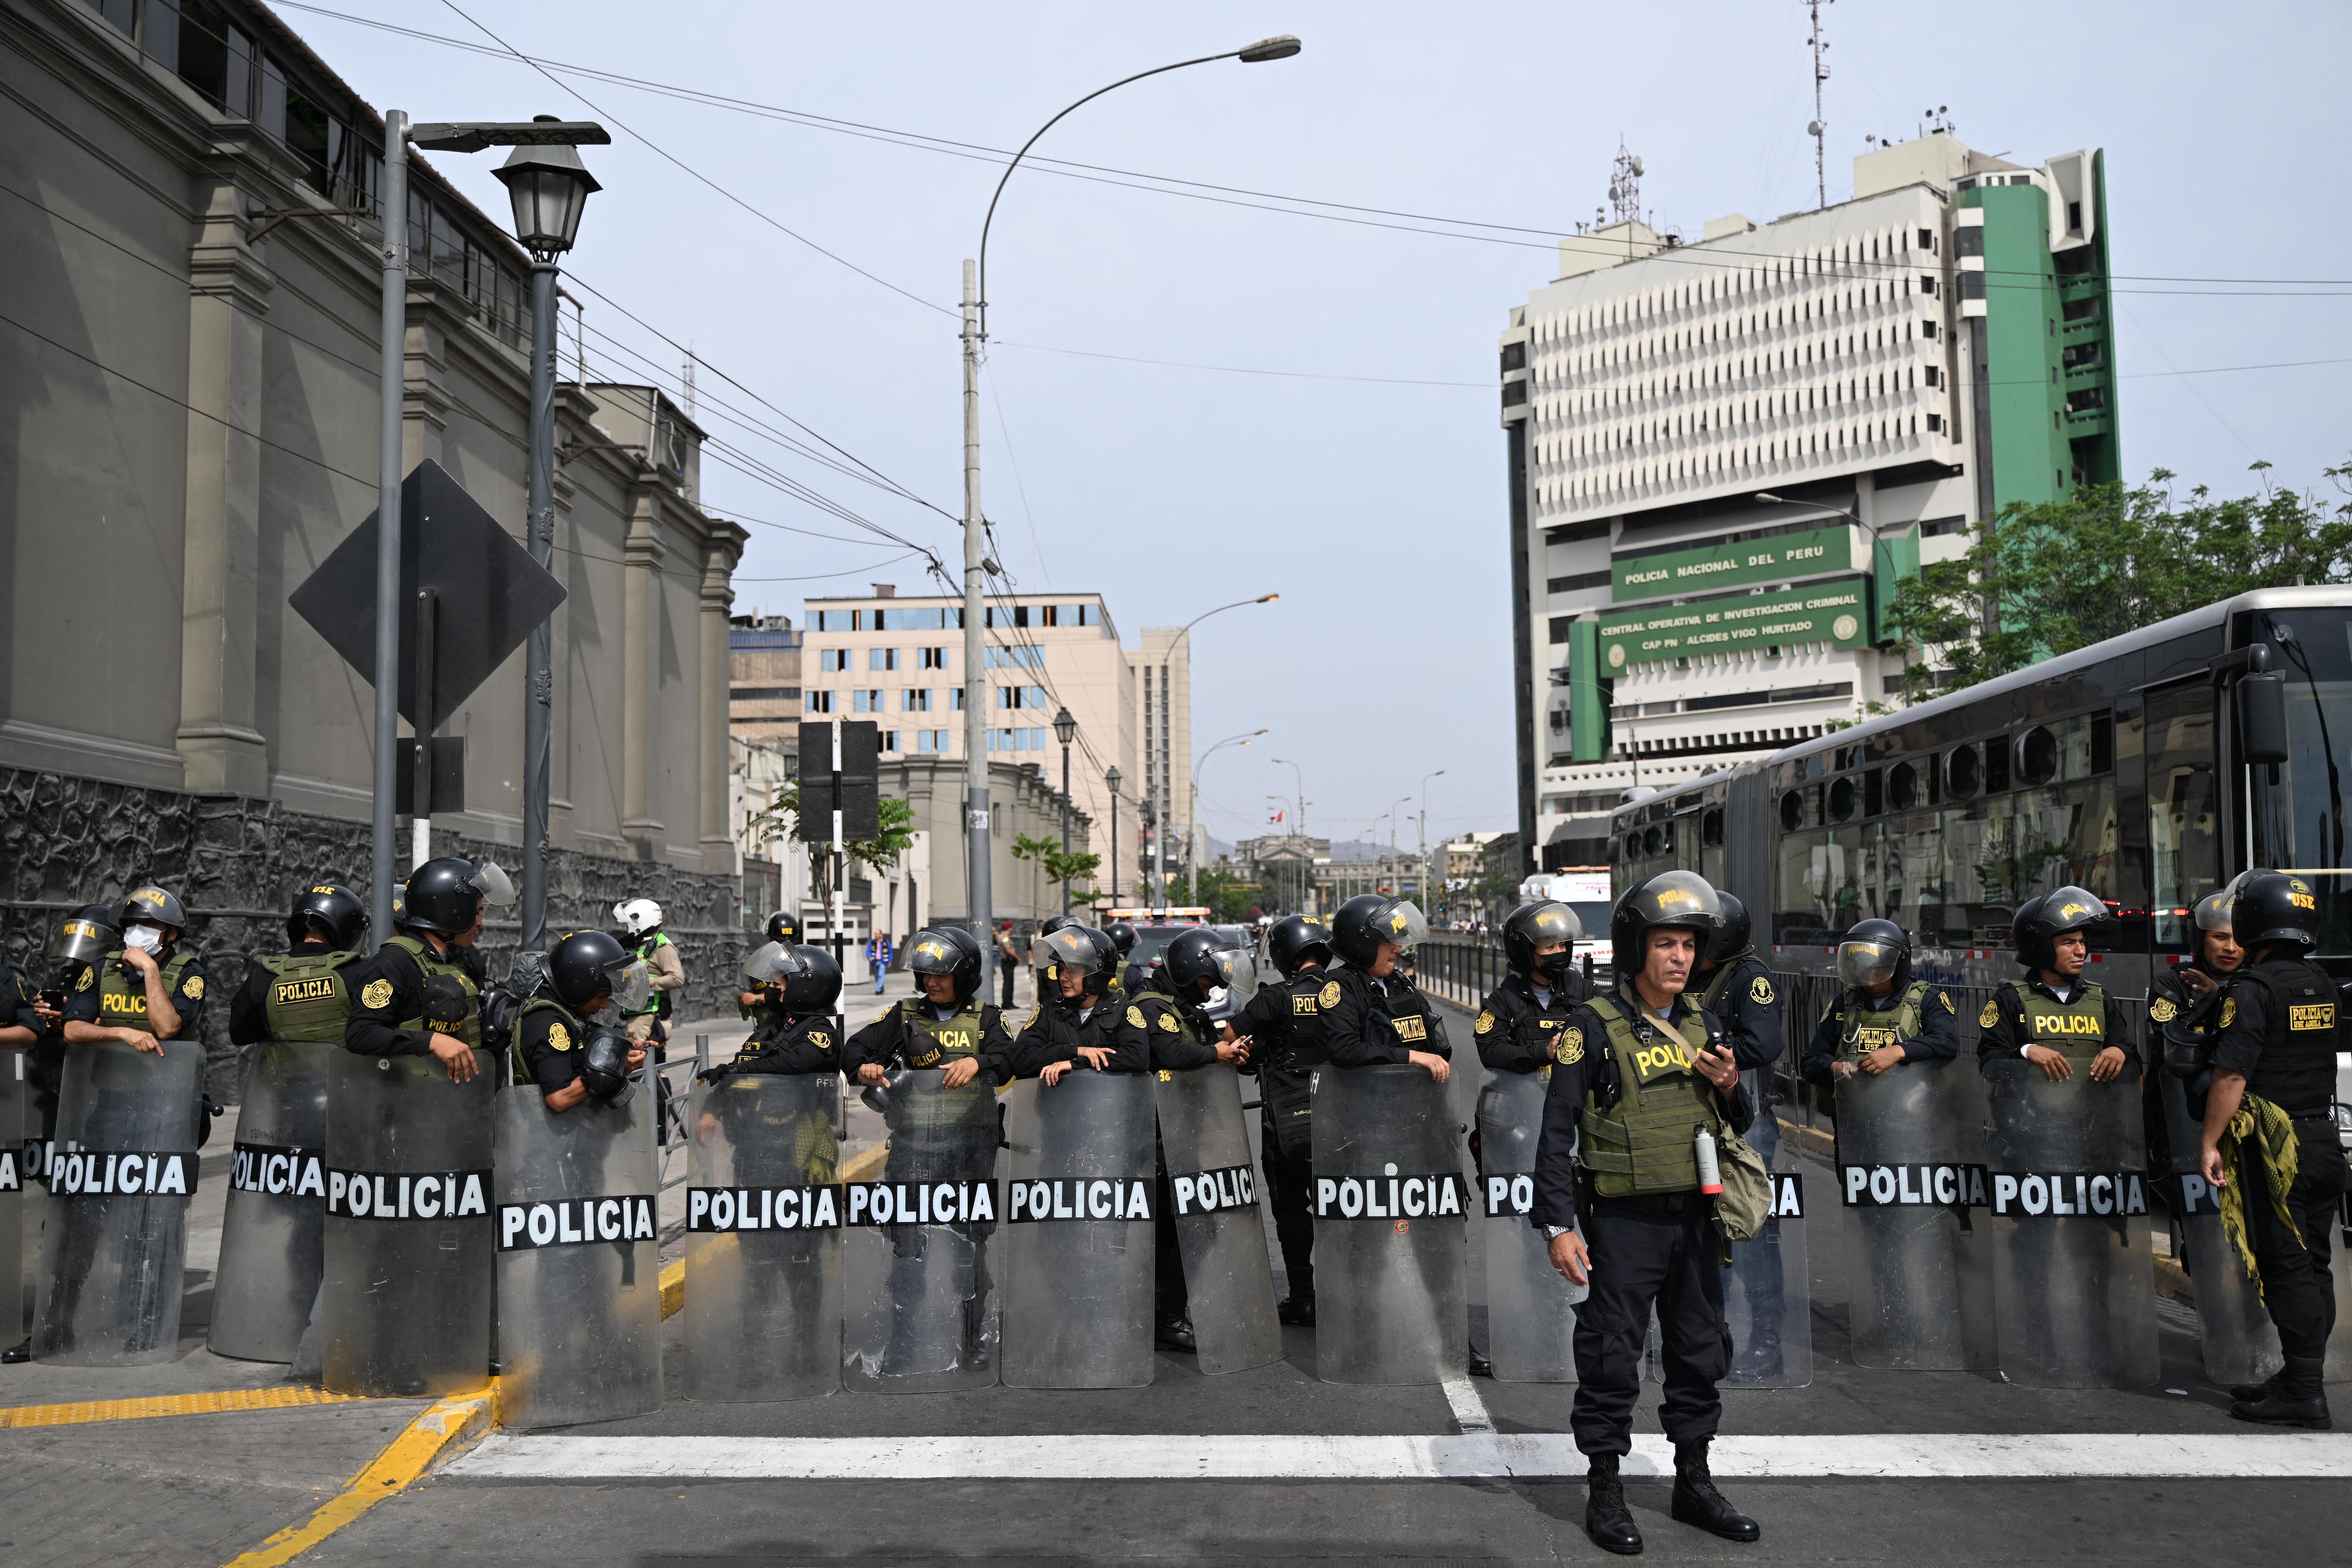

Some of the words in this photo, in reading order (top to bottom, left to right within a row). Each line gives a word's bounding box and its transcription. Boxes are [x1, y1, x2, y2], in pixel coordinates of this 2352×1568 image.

[1626, 570, 1669, 585] POLICIA
[1677, 559, 1738, 577] NACIONAL
[1748, 554, 1775, 566] DEL
[1786, 546, 1824, 561] PERU
[1601, 622, 1645, 636] CENTRAL
[1648, 616, 1701, 630] OPERATIVA
[1706, 613, 1720, 623] DE
[1724, 602, 1802, 621] INVESTIGACION
[1806, 594, 1858, 609] CRIMINAL
[1642, 640, 1661, 650] CAP
[1687, 632, 1729, 645] ALCIDES
[1731, 628, 1757, 639] VIGO
[1762, 621, 1812, 635] HURTADO
[312, 886, 335, 895] USE
[2290, 893, 2315, 910] USE
[103, 994, 147, 1013] POLIC
[278, 979, 332, 1002] POLICIA
[2035, 1016, 2100, 1034] POLICIA
[2293, 1008, 2321, 1020] POLICIA
[931, 1031, 970, 1047] ICIA
[1860, 1030, 1883, 1044] POLICIA
[910, 1048, 941, 1067] POLICIA
[1636, 1044, 1692, 1076] POLIC
[51, 1154, 186, 1194] POLICIA
[1175, 1168, 1259, 1214] POLICI
[1754, 1178, 1771, 1189] MA
[1846, 1166, 1987, 1203] POLICIA
[329, 1171, 486, 1218] POLICIA
[690, 1188, 838, 1229] POLICIA
[850, 1183, 993, 1223] POLICIA
[1011, 1180, 1150, 1219] POLICIA
[1318, 1177, 1460, 1217] POLICIA
[1994, 1175, 2146, 1214] POLICIA
[503, 1199, 653, 1247] POLICIA
